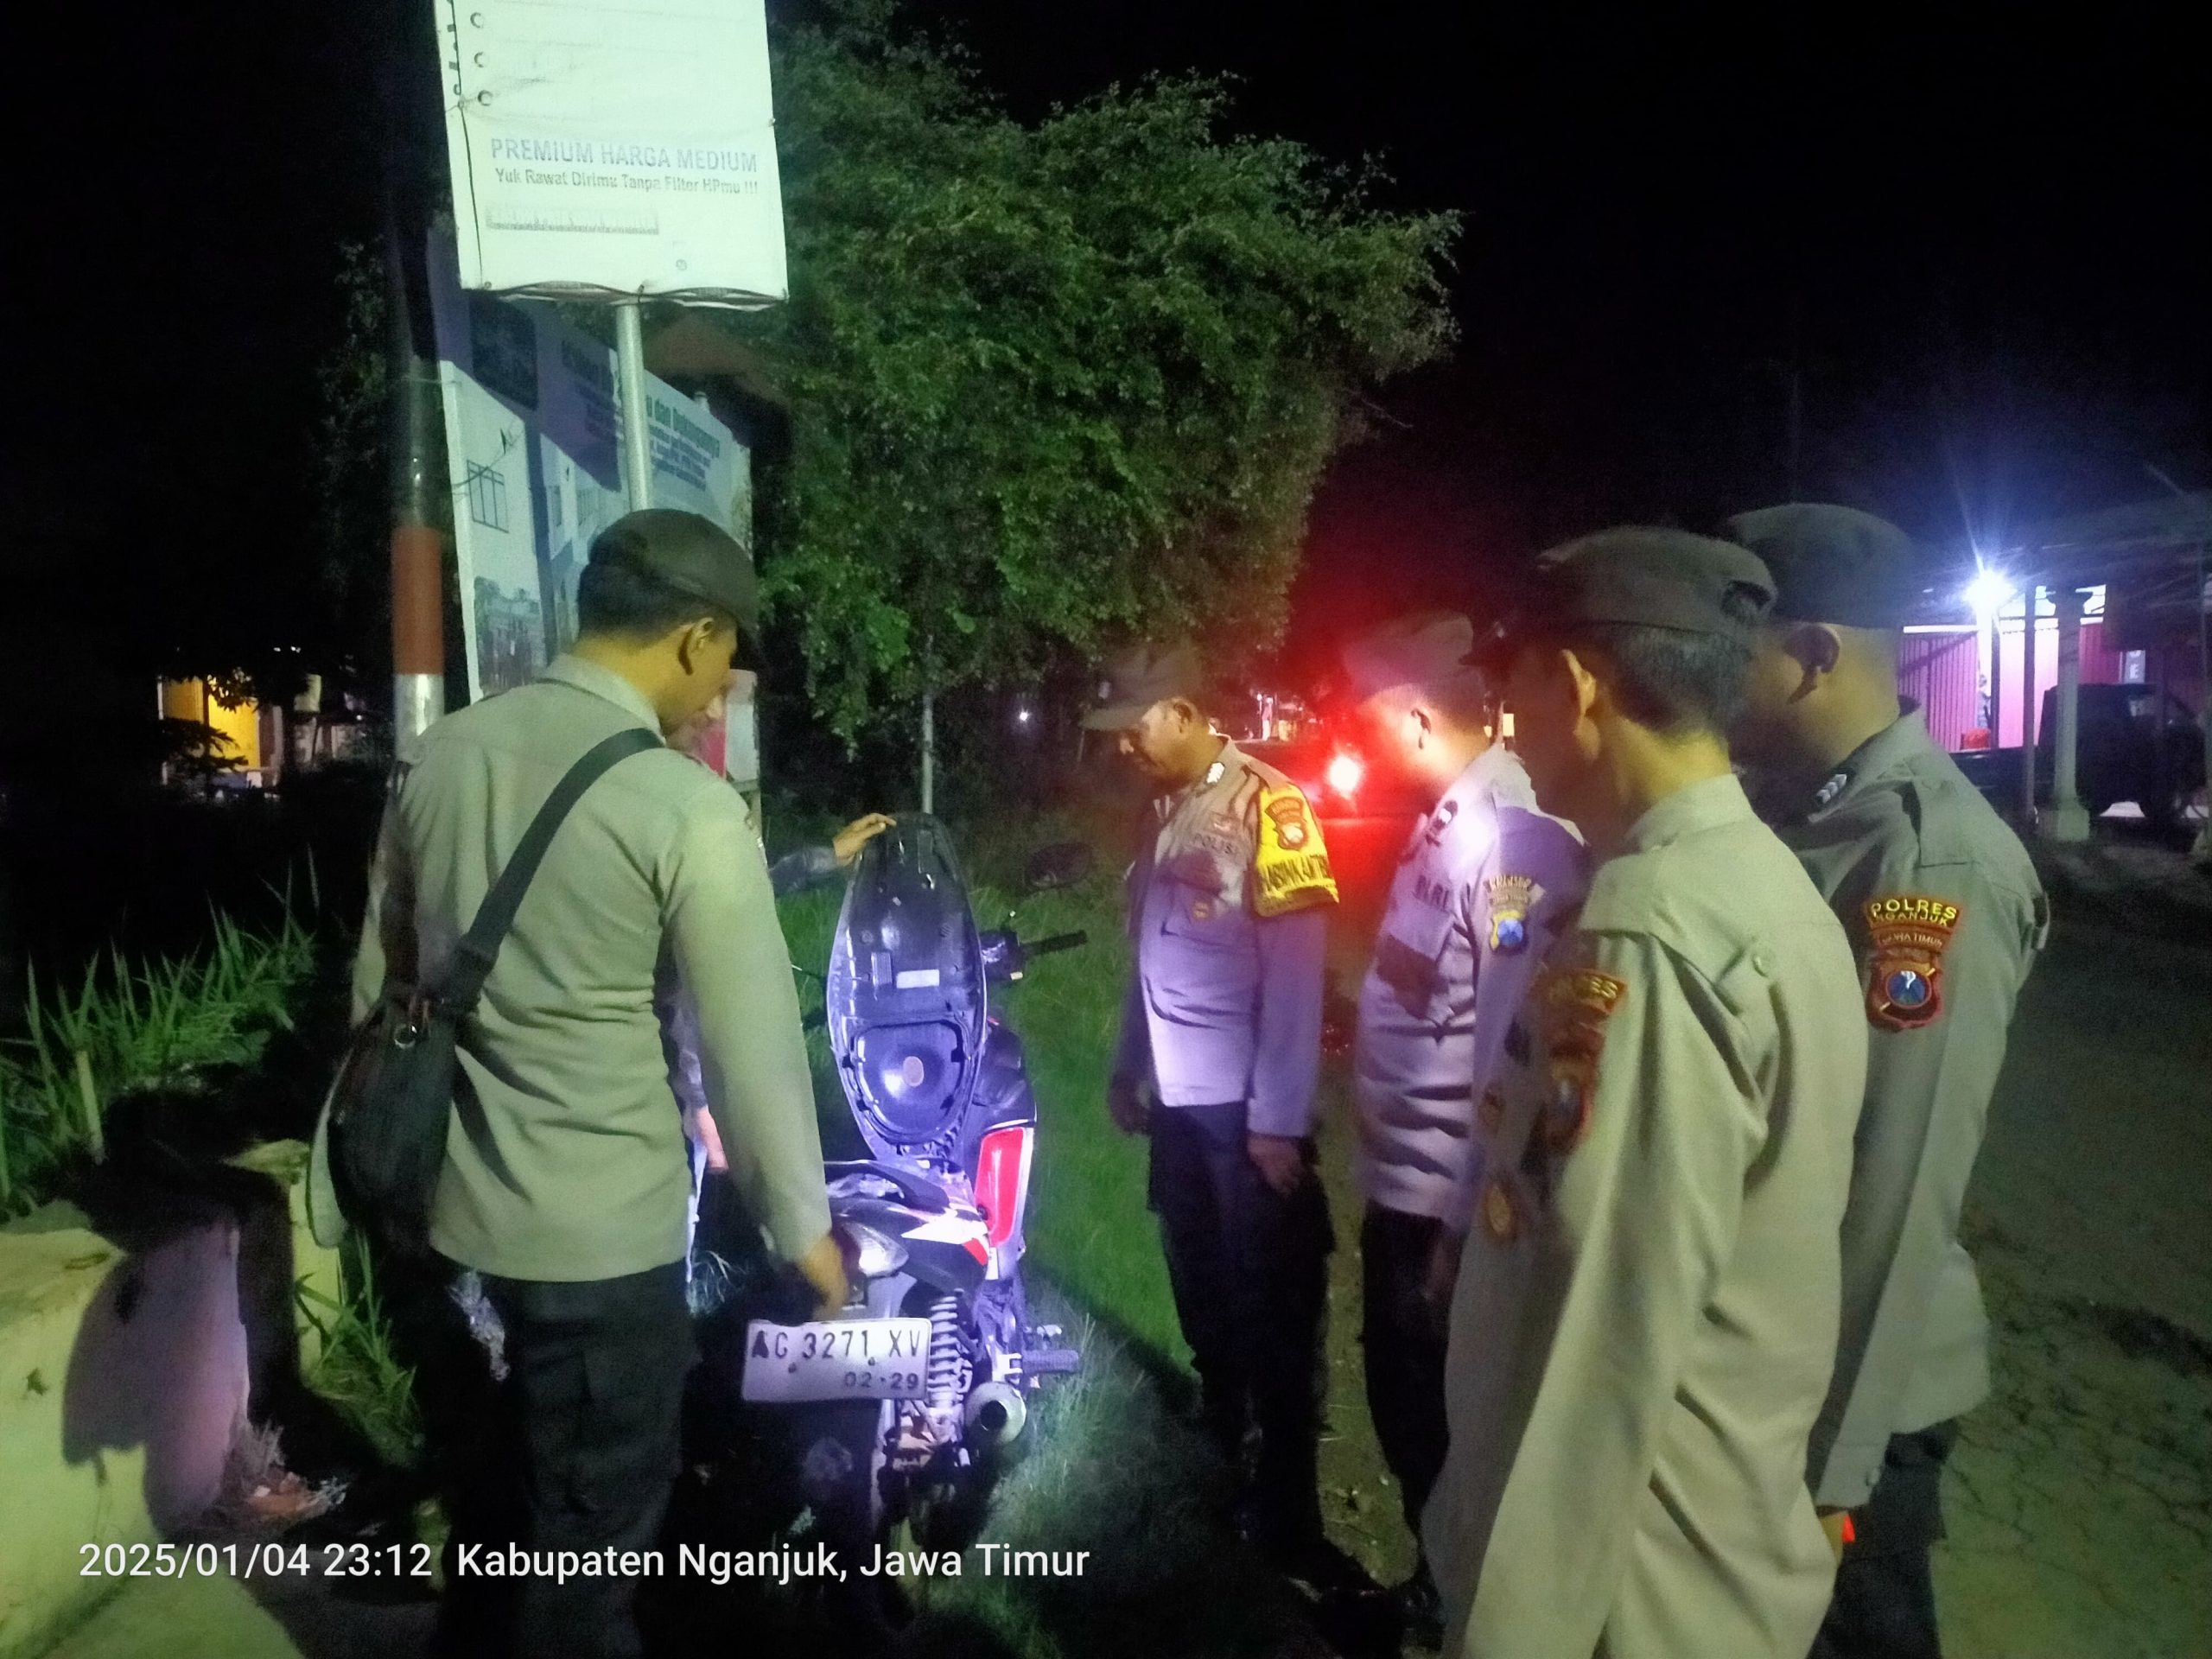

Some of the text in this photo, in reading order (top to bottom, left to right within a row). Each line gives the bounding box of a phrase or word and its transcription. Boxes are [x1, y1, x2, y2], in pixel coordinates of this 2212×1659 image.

[491, 138, 757, 173] PREMIUM HARGA MEDIUM
[495, 168, 520, 183] Yuk
[525, 169, 568, 186] Rawat
[572, 171, 617, 188] Dirimu
[621, 174, 661, 193] Tanpa
[664, 175, 698, 192] Filter
[1871, 898, 1957, 919] POLRES
[751, 1329, 921, 1359] AG 3271 XV
